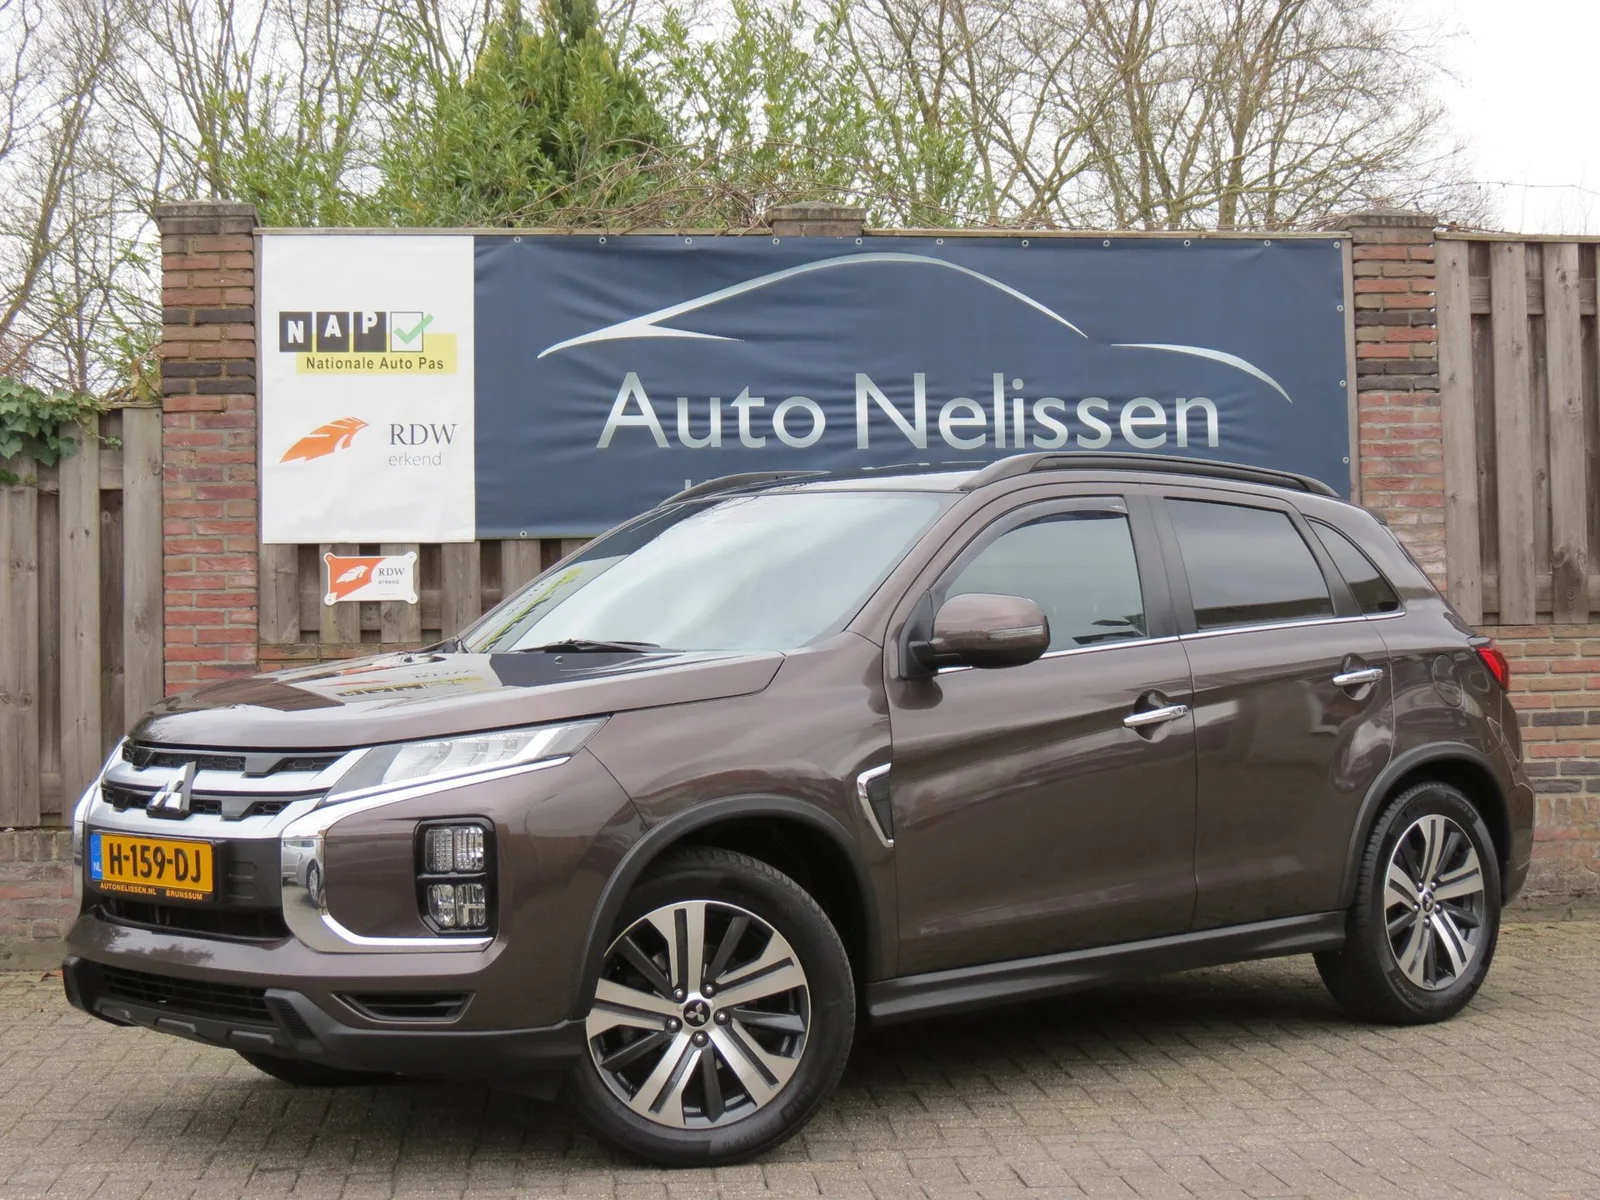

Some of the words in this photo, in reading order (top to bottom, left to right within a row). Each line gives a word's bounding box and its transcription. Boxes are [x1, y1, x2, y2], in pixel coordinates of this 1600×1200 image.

[306, 356, 374, 370] Nationale
[379, 356, 413, 370] Auto
[418, 356, 444, 370] Pas
[596, 371, 826, 450] Auto
[855, 371, 1220, 450] Nelissen
[390, 424, 456, 445] RDW
[388, 451, 442, 466] erkend
[378, 568, 404, 576] RDW
[93, 862, 102, 872] NL
[109, 843, 201, 882] H-159-DJ
[100, 883, 156, 895] AUTONELISSEN.NL
[166, 890, 202, 900] BRUNSSUM
